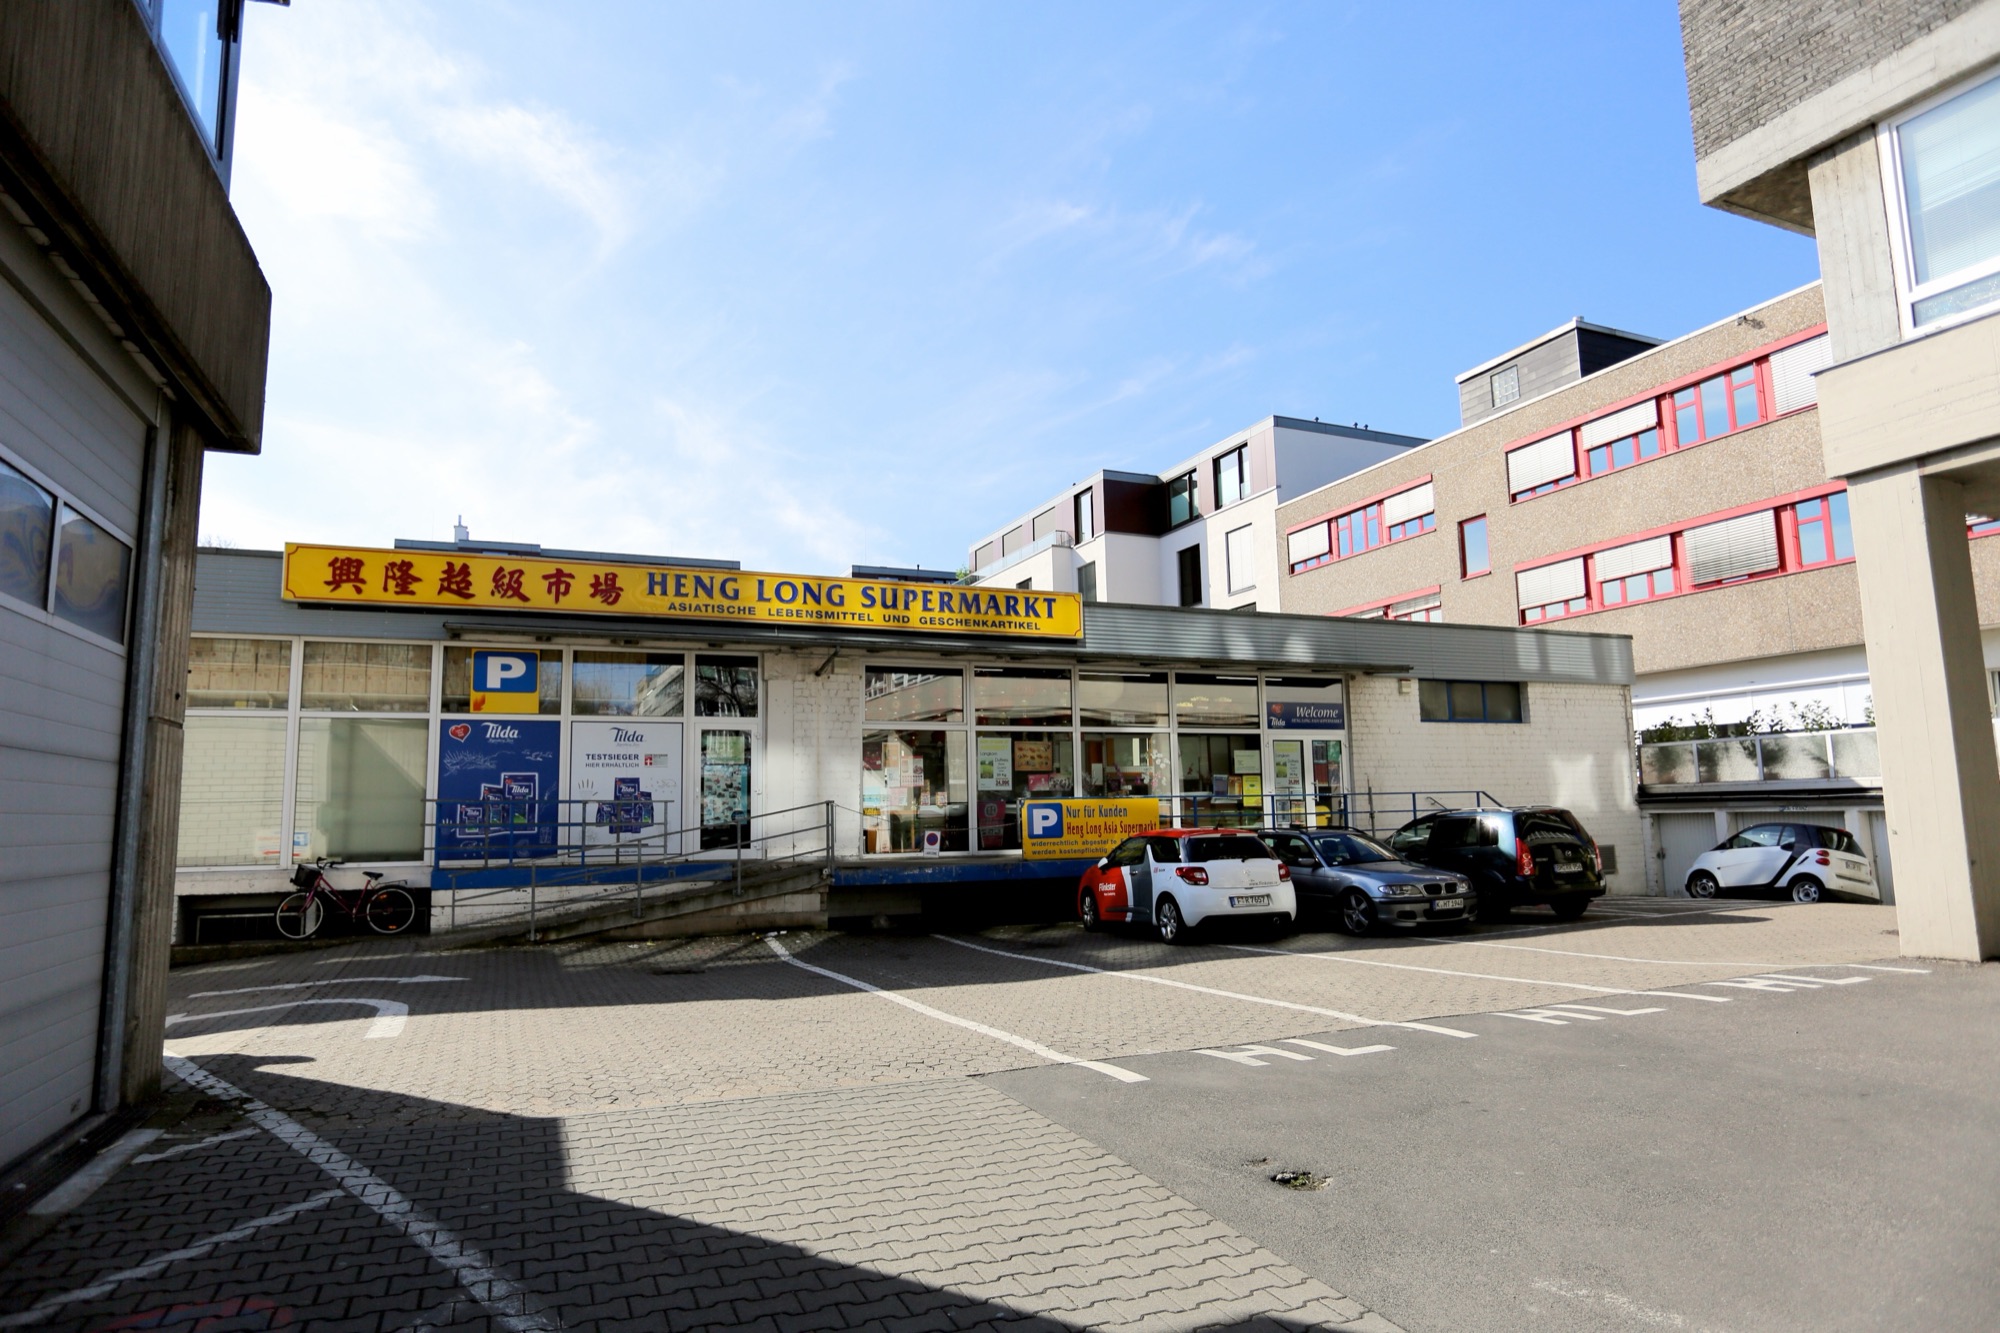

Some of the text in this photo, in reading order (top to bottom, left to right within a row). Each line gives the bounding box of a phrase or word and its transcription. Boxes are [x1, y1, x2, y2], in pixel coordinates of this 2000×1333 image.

[323, 556, 625, 606] 興隆超級市場
[646, 571, 1057, 619] HENG LONG SUPERMARKT
[668, 602, 1041, 631] ASIATISCHE LEBENSMITTEL UND GESCHENKARTIKEL
[486, 656, 527, 689] P
[1296, 706, 1339, 718] Welcome
[481, 721, 519, 739] Tilda
[610, 726, 644, 743] Tilda
[585, 753, 640, 761] TESTSIEGER
[510, 783, 530, 794] Tilda
[1066, 805, 1128, 818] Nur für Kunden
[1032, 808, 1058, 835] P
[1066, 820, 1157, 838] Heng Long Asia Supermarkt
[1031, 839, 1079, 847] widerrechtlich
[1032, 847, 1057, 855] werden
[1060, 846, 1108, 855] kostenpflichtig
